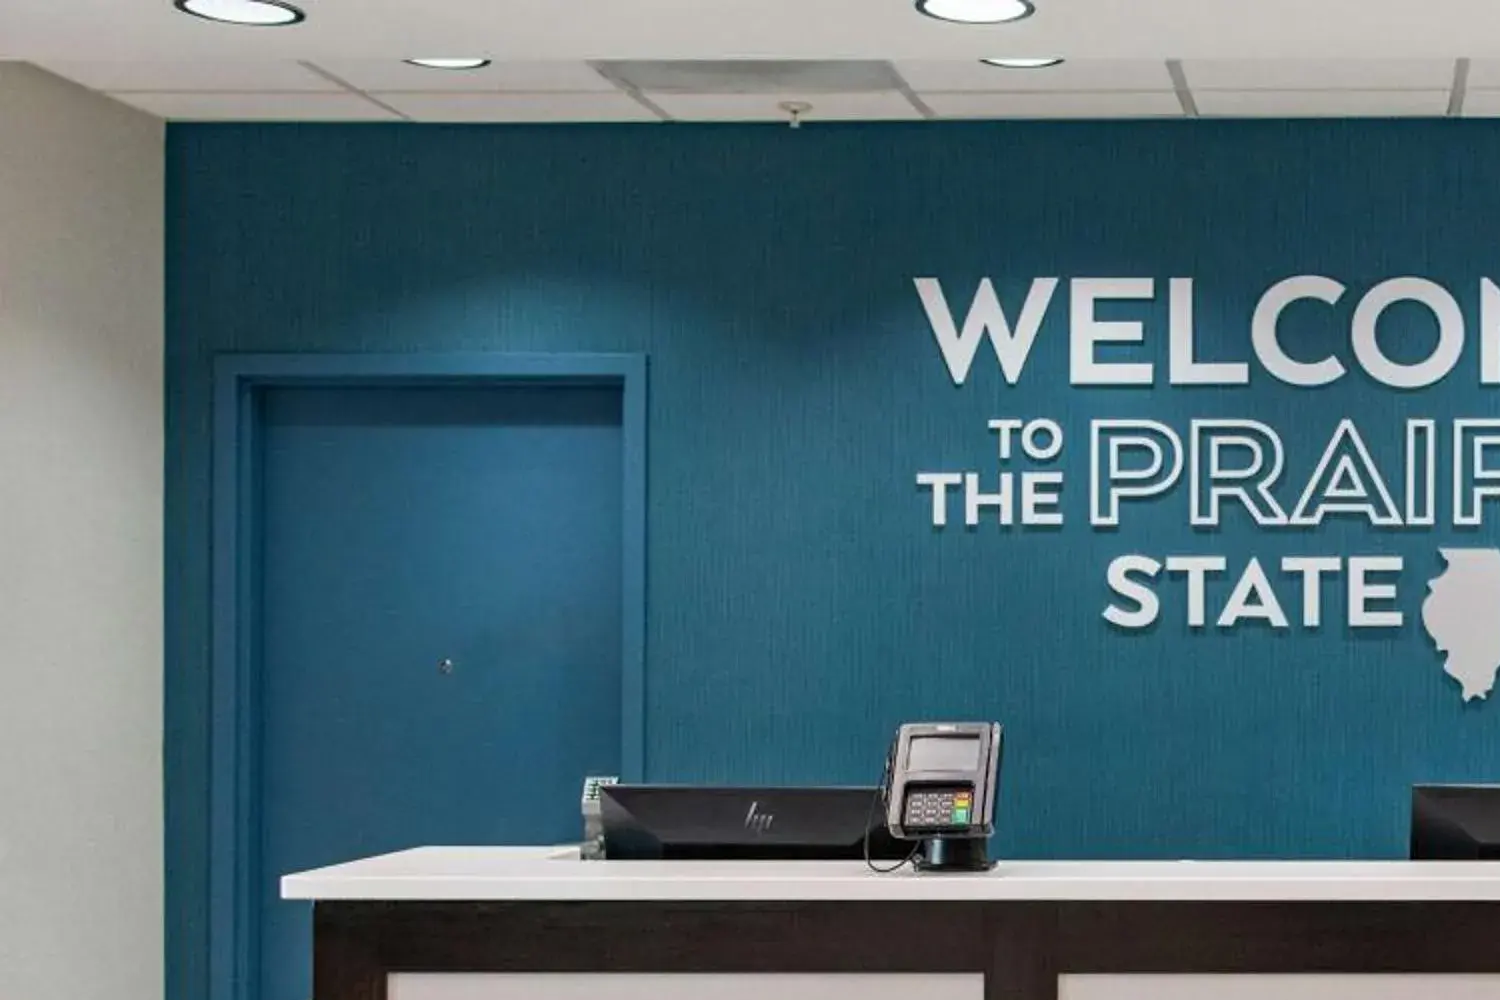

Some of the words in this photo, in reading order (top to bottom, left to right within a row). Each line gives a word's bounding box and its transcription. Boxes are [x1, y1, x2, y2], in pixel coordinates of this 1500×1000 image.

[987, 417, 1064, 460] TO
[916, 471, 1064, 525] THE
[1101, 554, 1405, 628] STATE
[744, 801, 774, 837] hp
